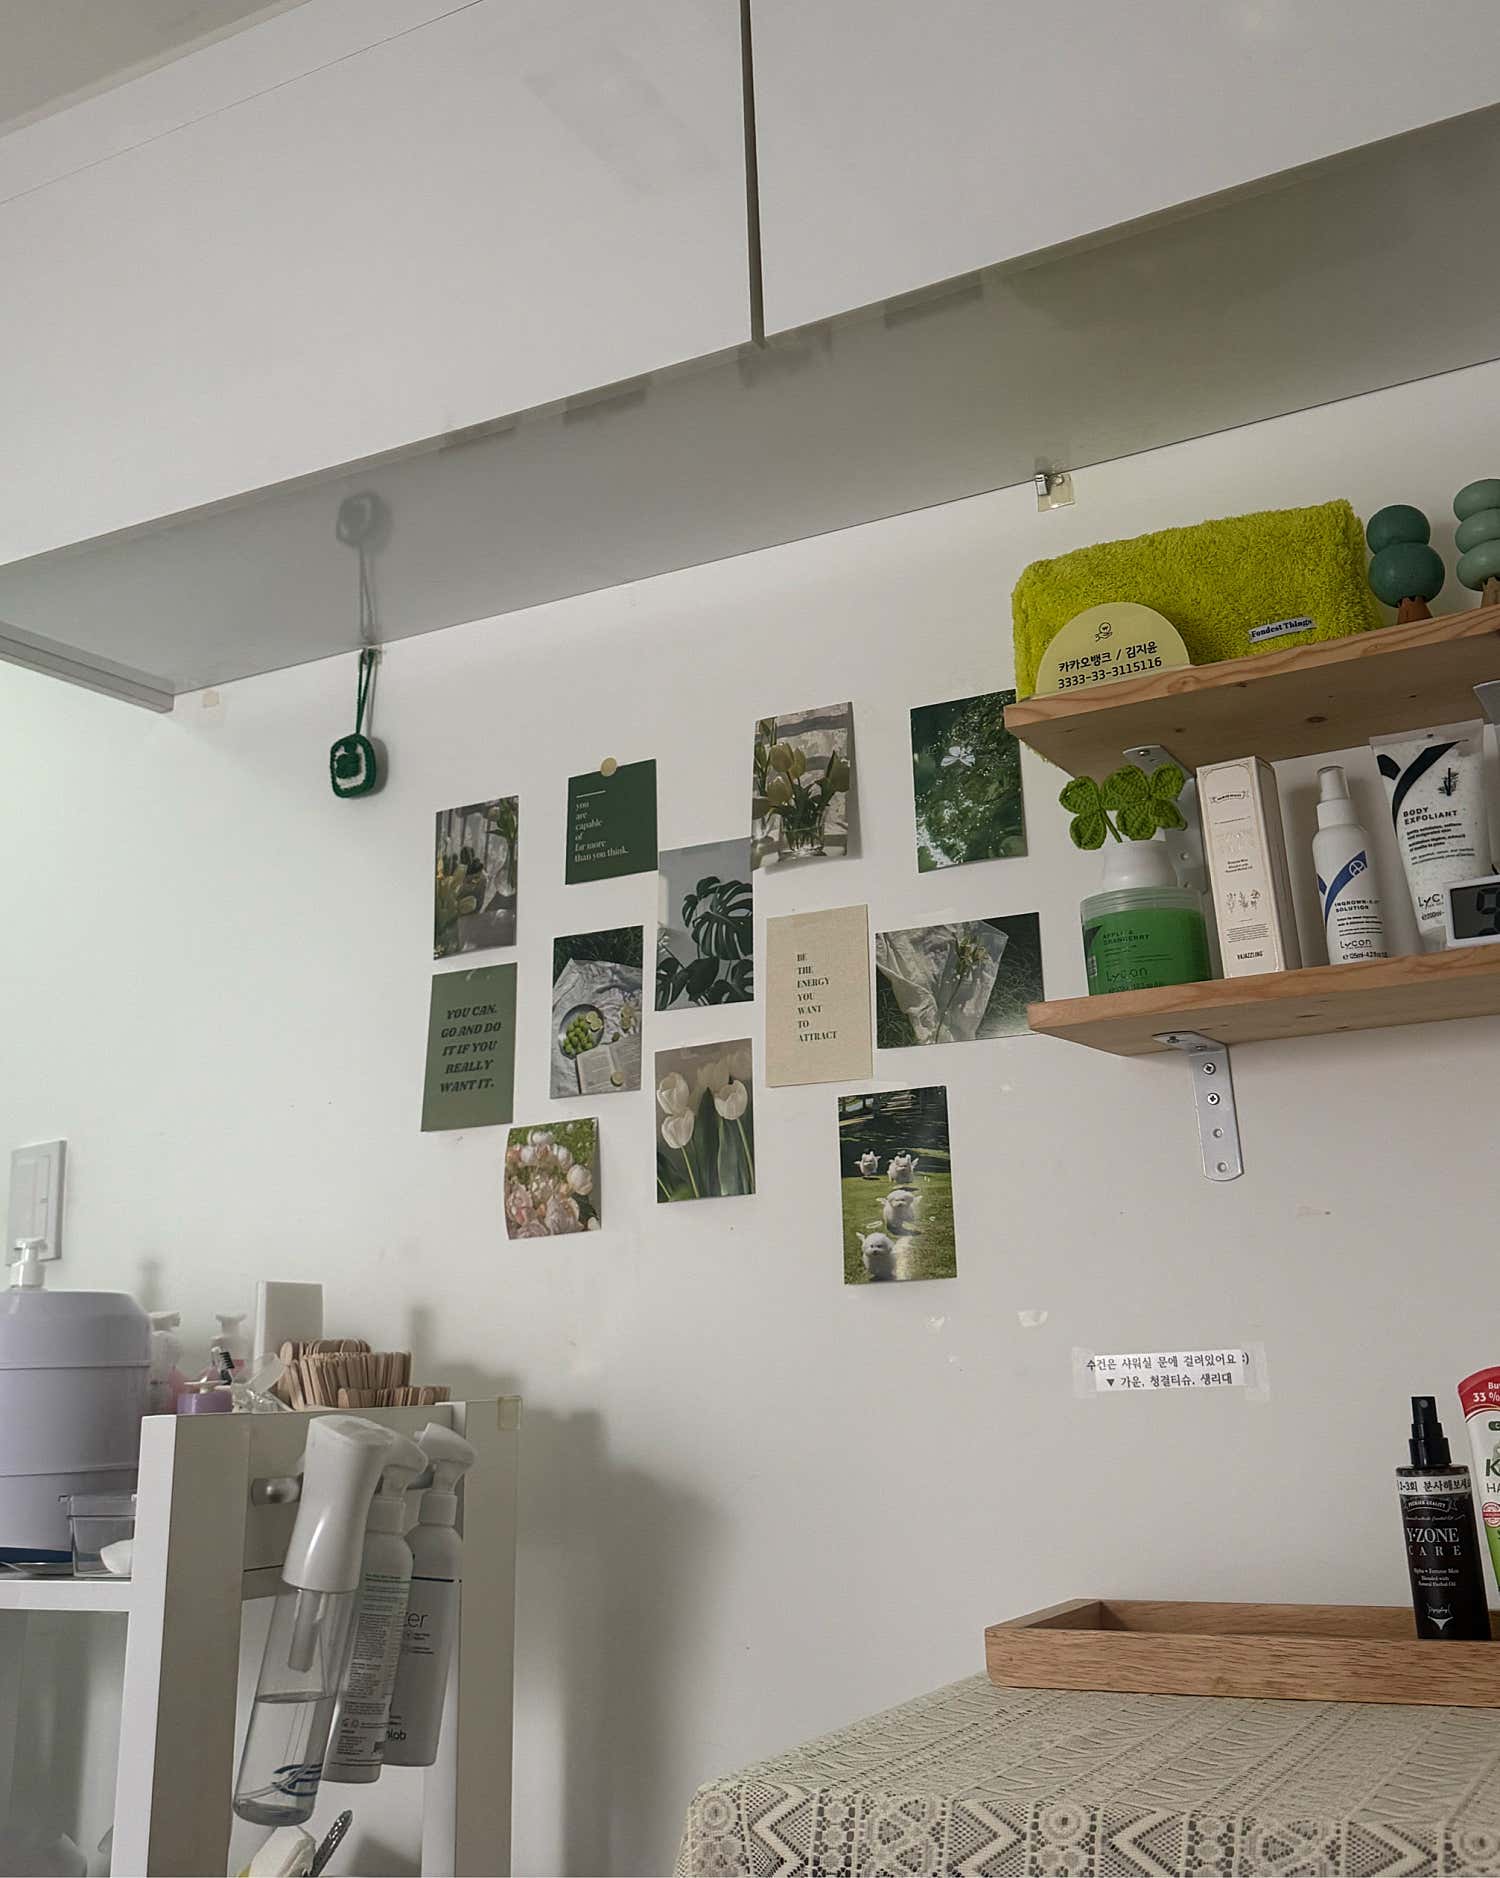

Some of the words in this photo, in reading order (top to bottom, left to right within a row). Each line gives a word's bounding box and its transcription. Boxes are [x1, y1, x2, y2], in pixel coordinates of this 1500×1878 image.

[1251, 625, 1283, 638] Fondest
[1283, 619, 1312, 629] Things
[1058, 652, 1112, 672] 카카오뱅크
[1116, 649, 1122, 660] /
[1126, 641, 1158, 659] 김지윤
[1058, 657, 1162, 689] 3333-33-3115116
[576, 802, 590, 812] you
[1403, 807, 1429, 818] BODY
[576, 812, 588, 820] are
[1404, 810, 1458, 826] EXFOLIANT
[575, 818, 603, 831] capable
[575, 832, 584, 841] of
[575, 842, 587, 852] far
[587, 840, 607, 850] more
[574, 852, 592, 862] than
[592, 851, 606, 861] you
[607, 845, 629, 857] think.
[1336, 905, 1369, 913] SOLUTION
[797, 953, 807, 961] BE
[798, 966, 812, 975] THE
[797, 977, 829, 989] ENERGY
[798, 993, 814, 1001] YOU
[447, 1008, 471, 1020] YOU
[472, 1004, 497, 1017] CAN.
[798, 1005, 822, 1015] WANT
[441, 1027, 457, 1038] GO
[457, 1023, 481, 1036] AND
[484, 1021, 501, 1033] DO
[798, 1020, 809, 1028] TO
[800, 1031, 838, 1042] ATTRACT
[442, 1045, 457, 1057] IT
[457, 1044, 471, 1055] IF
[472, 1040, 498, 1053] YOU
[445, 1059, 494, 1075] REALLY
[440, 1080, 477, 1093] WANT
[478, 1078, 495, 1089] IT.
[1087, 1358, 1117, 1371] 수건은
[1122, 1355, 1152, 1370] 샤워실
[1157, 1355, 1178, 1368] 문에
[1184, 1354, 1236, 1367] 걸려있어요
[1121, 1376, 1145, 1388] 가운,
[1200, 1372, 1233, 1386] 생리대
[1473, 1393, 1486, 1402] 33
